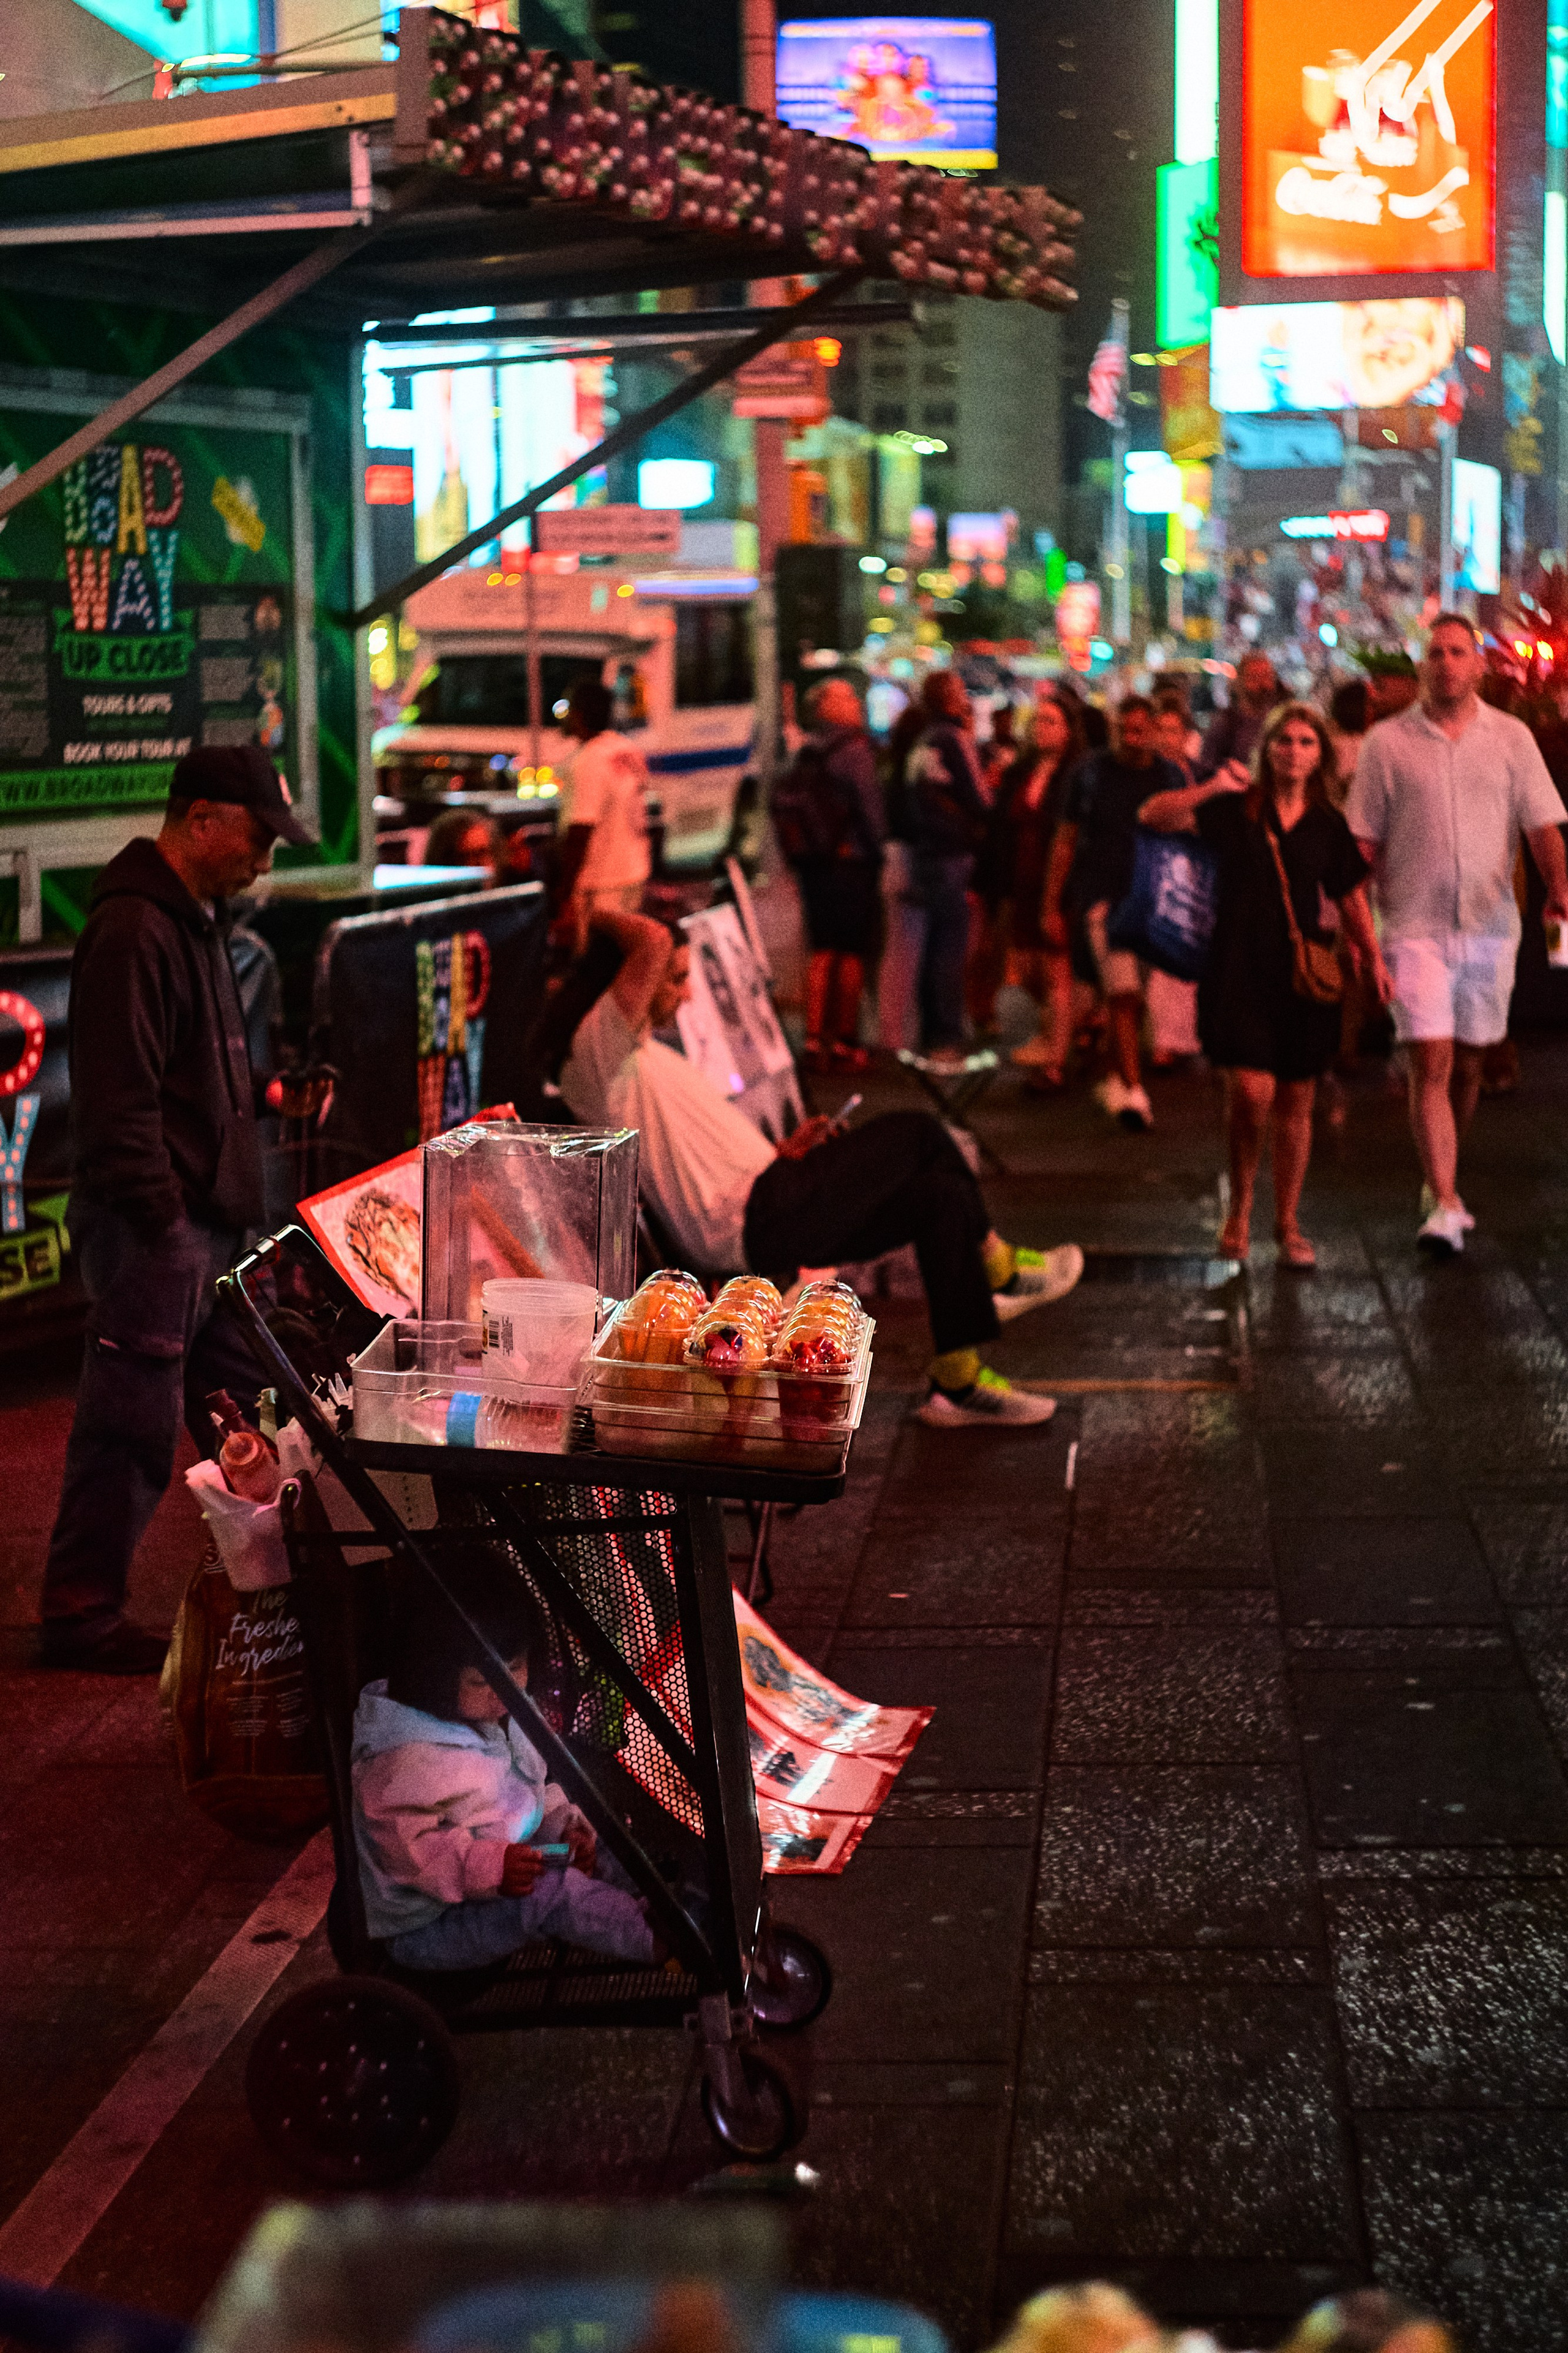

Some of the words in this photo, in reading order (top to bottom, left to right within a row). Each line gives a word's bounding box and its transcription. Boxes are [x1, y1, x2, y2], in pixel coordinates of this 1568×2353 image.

[67, 643, 101, 670] UP
[109, 640, 185, 673] CLOSE
[229, 1608, 302, 1644] Freshe
